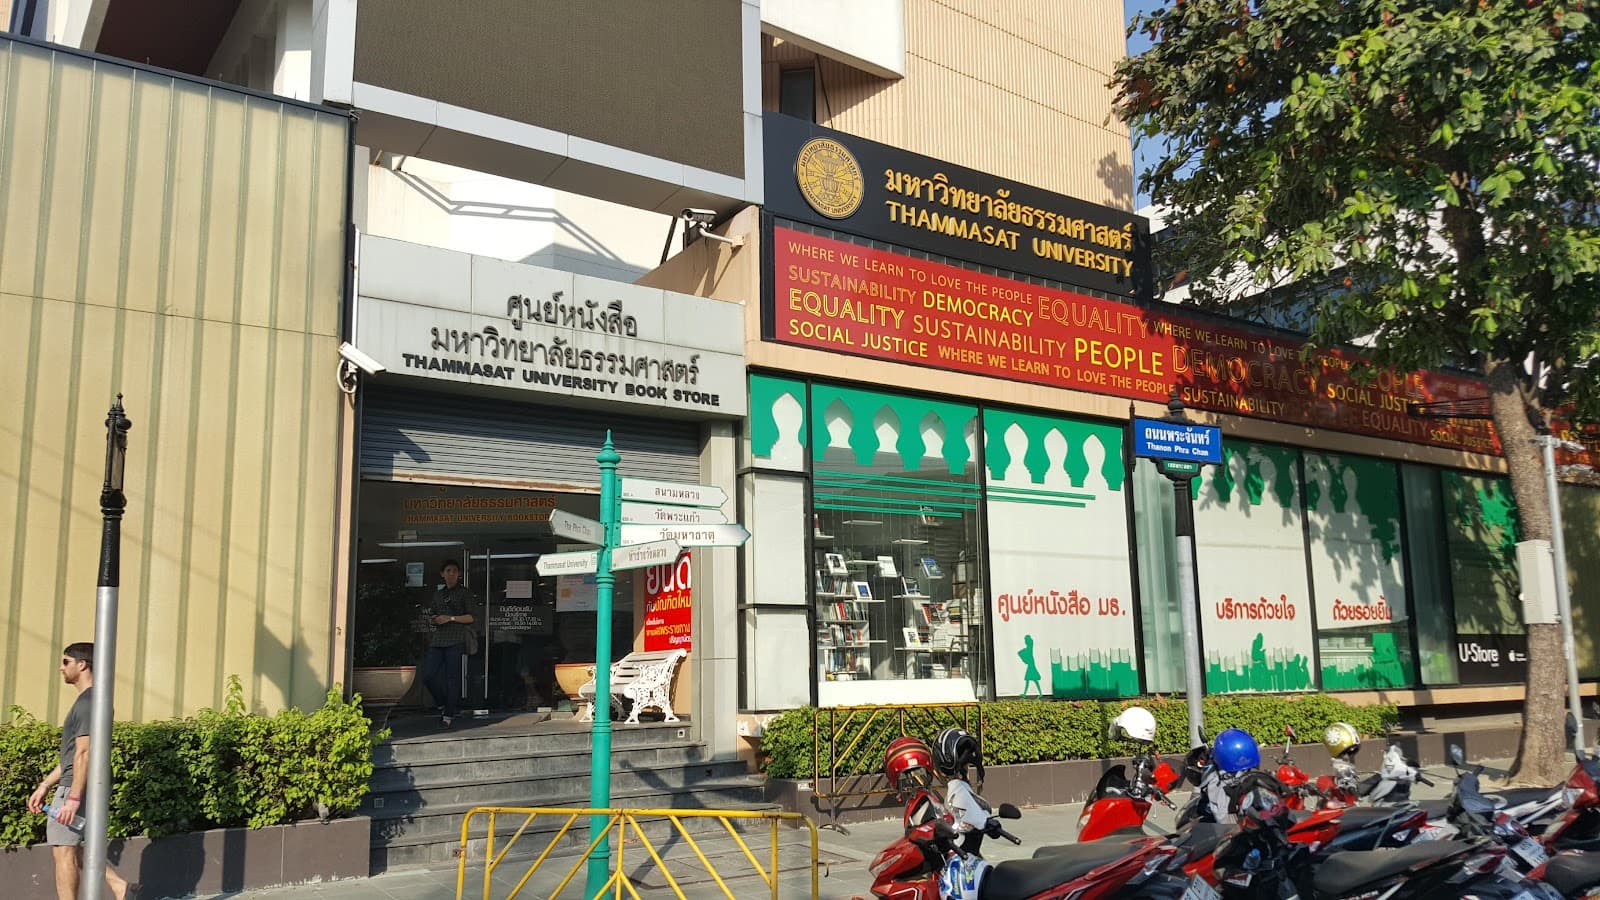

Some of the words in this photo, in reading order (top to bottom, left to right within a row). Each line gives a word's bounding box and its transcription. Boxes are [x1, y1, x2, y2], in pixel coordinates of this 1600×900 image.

[884, 168, 1133, 251] มหาวิทยาลัยธรรมศาสตร์
[886, 200, 1021, 251] THAMMASAT
[1032, 237, 1134, 278] UNIVERSITY
[788, 241, 834, 262] WHERE
[840, 252, 859, 268] WE
[864, 258, 904, 278] LEARN
[909, 268, 926, 282] TO
[931, 273, 961, 290] LOVE
[965, 280, 987, 295] THE
[992, 286, 1032, 304] PEOPLE
[788, 264, 917, 304] SUSTAINABILITY
[923, 290, 1033, 327] DEMOCRACY
[507, 291, 637, 338] ศูนย์หนังสือ
[1038, 296, 1149, 339] EQUALITY
[789, 287, 905, 329] EQUALITY
[913, 314, 1067, 359] SUSTAINABILITY
[1074, 337, 1164, 377] PEOPLE
[789, 319, 854, 345] SOCIAL
[861, 332, 928, 358] JUSTICE
[1153, 321, 1191, 340] WHERE
[1195, 329, 1212, 343] WE
[1215, 334, 1248, 350] LEARN
[1251, 341, 1265, 354] TO
[1269, 345, 1294, 360] LOVE
[431, 325, 700, 385] มหาวิทยาลัยธรรมศาสตร์
[938, 345, 983, 365] WHERE
[987, 353, 1007, 369] WE
[1011, 358, 1050, 376] LEARN
[1053, 365, 1071, 379] TO
[1077, 369, 1107, 385] LOVE
[1110, 375, 1132, 390] THE
[402, 353, 515, 381] THAMMASAT
[522, 369, 618, 395] UNIVERSITY
[625, 383, 668, 400] BOOK
[673, 389, 720, 406] STORE
[1327, 383, 1376, 406] SOCIAL
[1183, 386, 1285, 416] SUSTAINABILITY
[1145, 427, 1211, 445] ถนนพระจันทร์
[1361, 410, 1429, 437] EQUALITY
[1430, 429, 1461, 445] SOCIAL
[1146, 442, 1172, 452] Thanon
[1174, 445, 1190, 454] Phra
[1192, 447, 1209, 456] Chan
[655, 487, 700, 500] สนามหลวง
[655, 508, 700, 523] วัดพระแก้ว
[660, 528, 715, 544] วัดมหาธาตุ
[567, 558, 588, 568] University
[998, 588, 1091, 622] ศูนย์หนังสือ
[1098, 597, 1126, 616] มธ.
[1216, 594, 1296, 621] บริการด้วยใจ
[1333, 595, 1393, 621] ด้วยรอยยิ้ม
